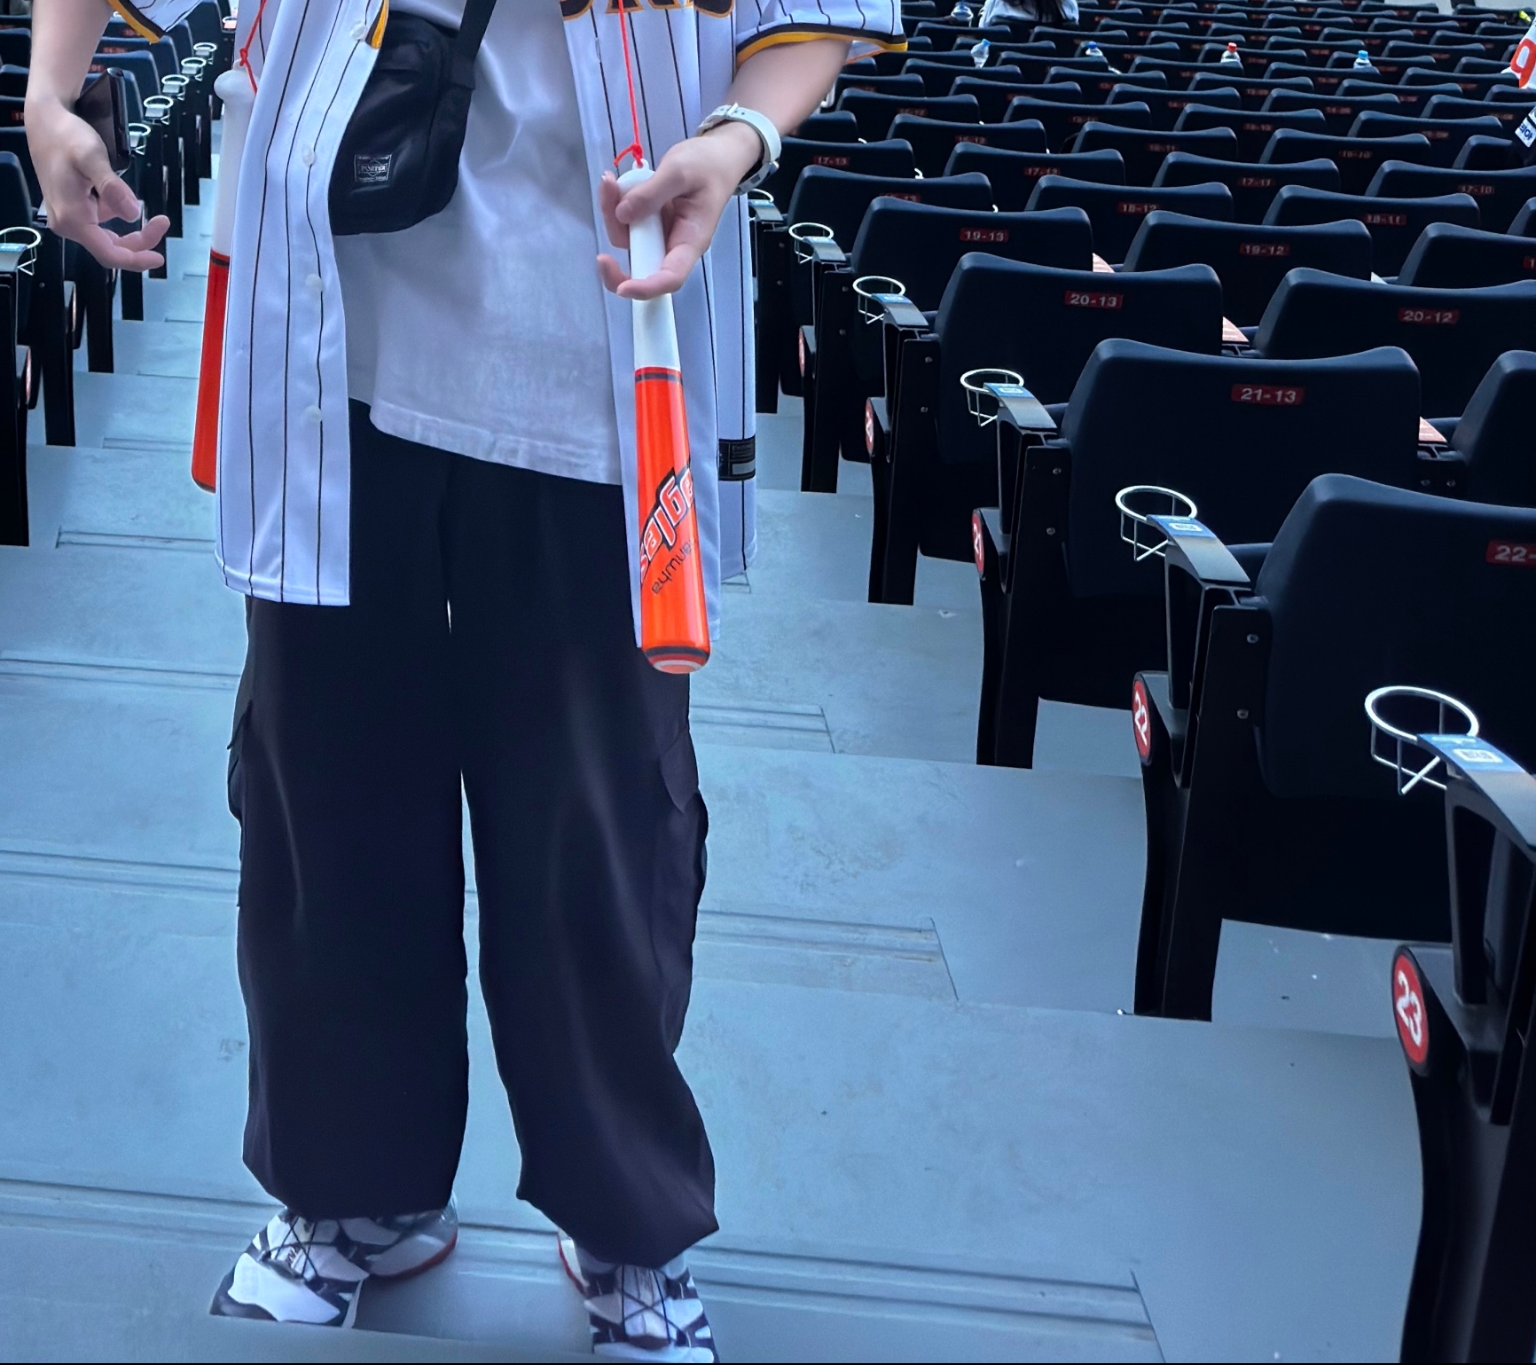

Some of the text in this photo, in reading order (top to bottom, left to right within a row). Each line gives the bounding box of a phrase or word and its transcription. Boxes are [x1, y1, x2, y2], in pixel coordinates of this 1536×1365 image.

[964, 231, 1005, 242] 19-13
[1244, 245, 1285, 257] 19-12
[1070, 292, 1117, 308] 20-13
[1403, 310, 1453, 326] 20-12
[1241, 388, 1297, 405] 21-13
[1133, 694, 1148, 747] 22
[1397, 971, 1422, 1047] 23
